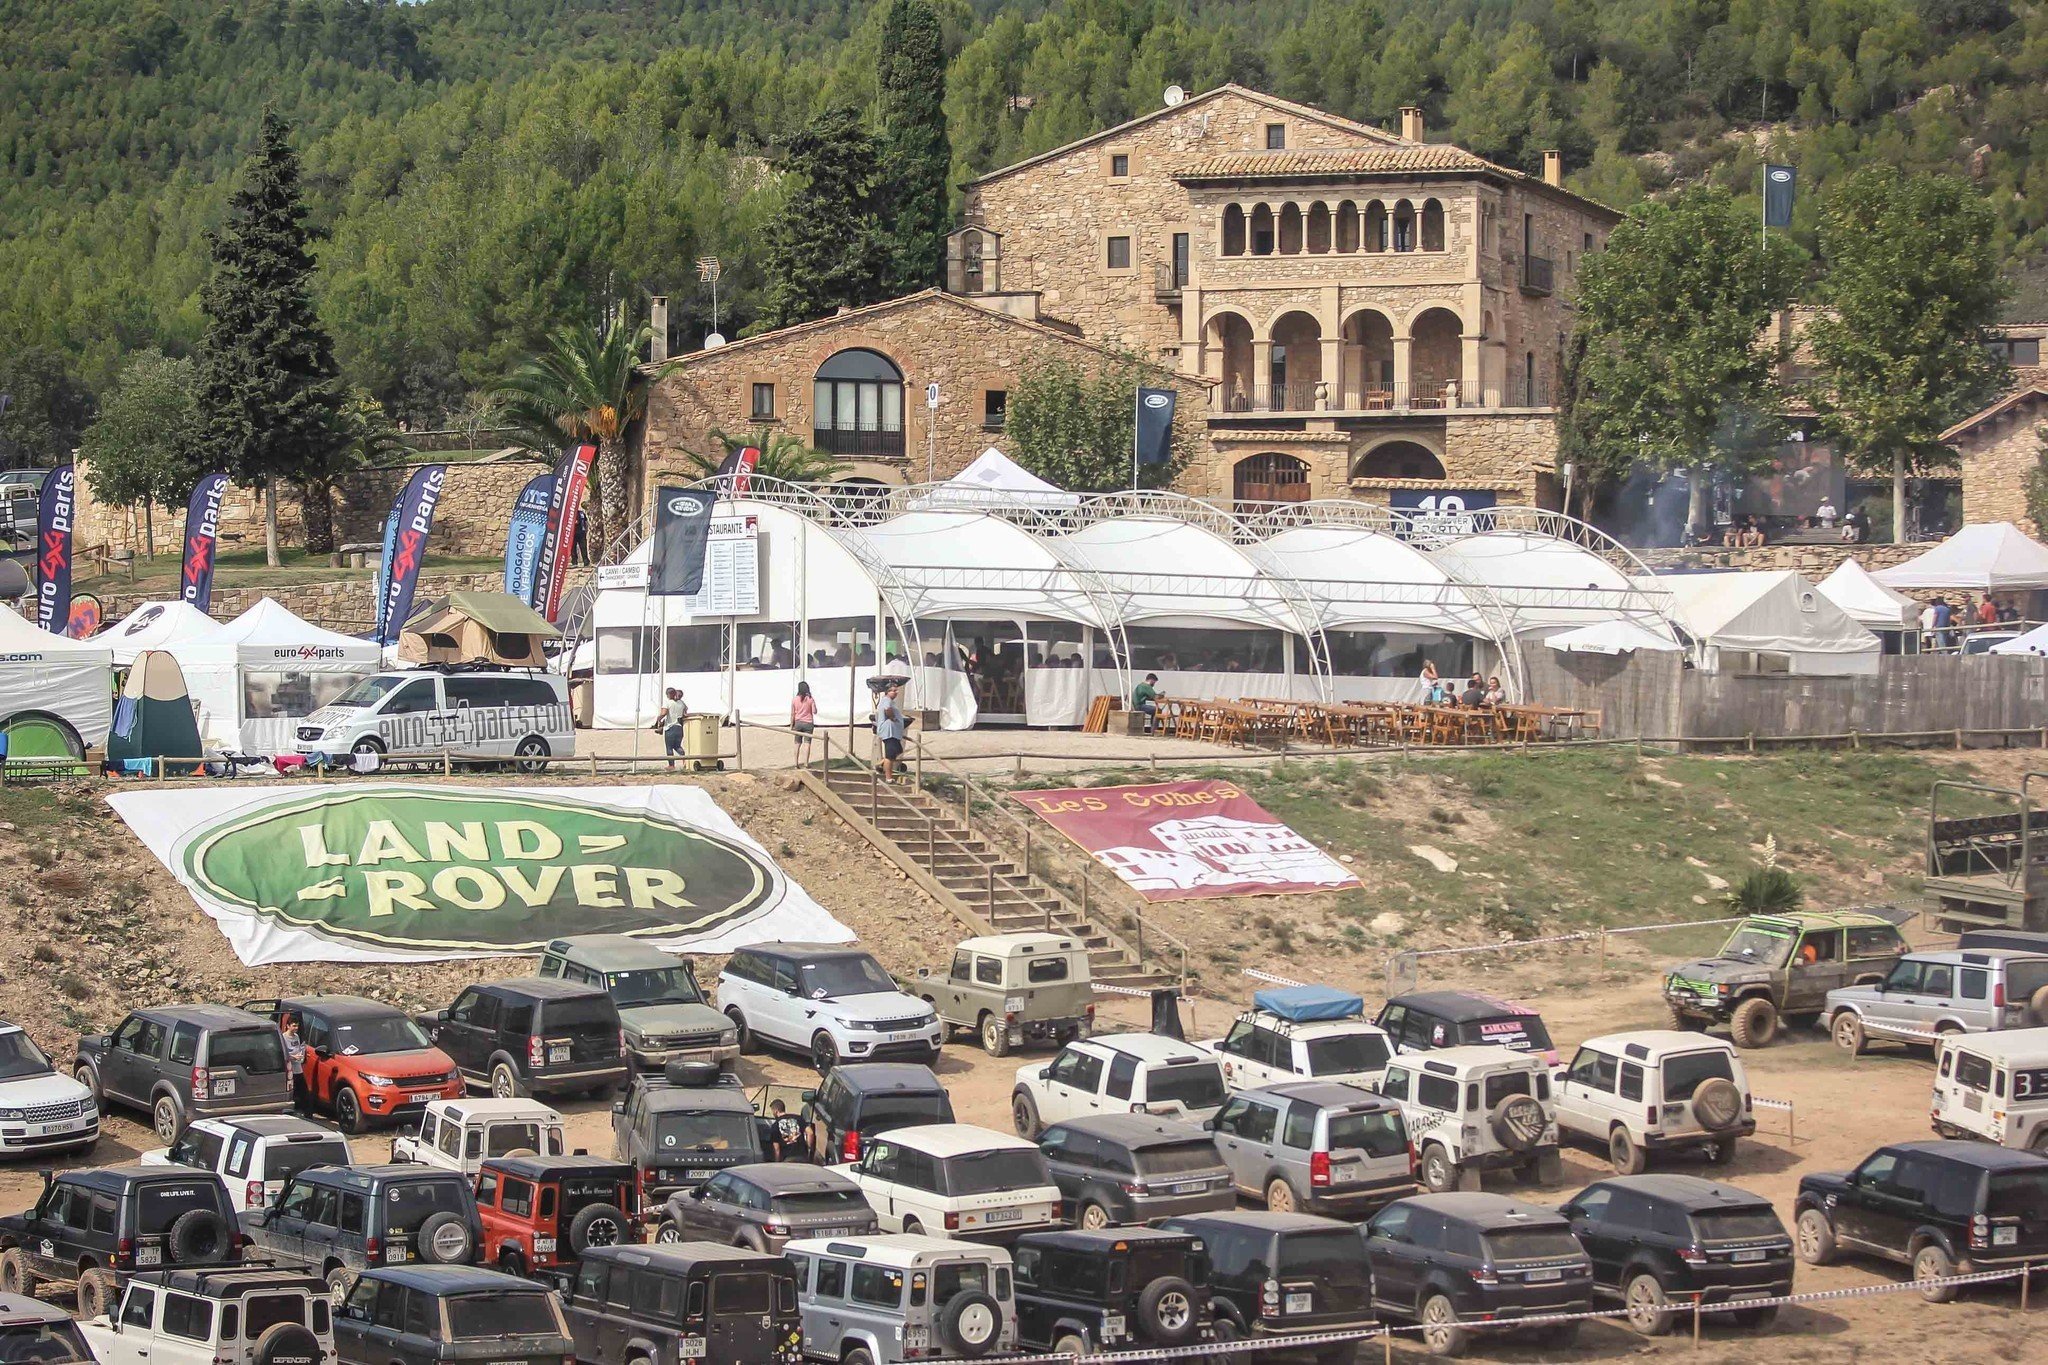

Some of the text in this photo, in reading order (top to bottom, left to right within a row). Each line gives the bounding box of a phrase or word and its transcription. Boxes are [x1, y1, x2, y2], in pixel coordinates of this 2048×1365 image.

[709, 523, 742, 535] STAURANTE
[1027, 787, 1240, 814] Les Comes
[297, 820, 564, 867] LAND
[361, 864, 700, 917] ROVER
